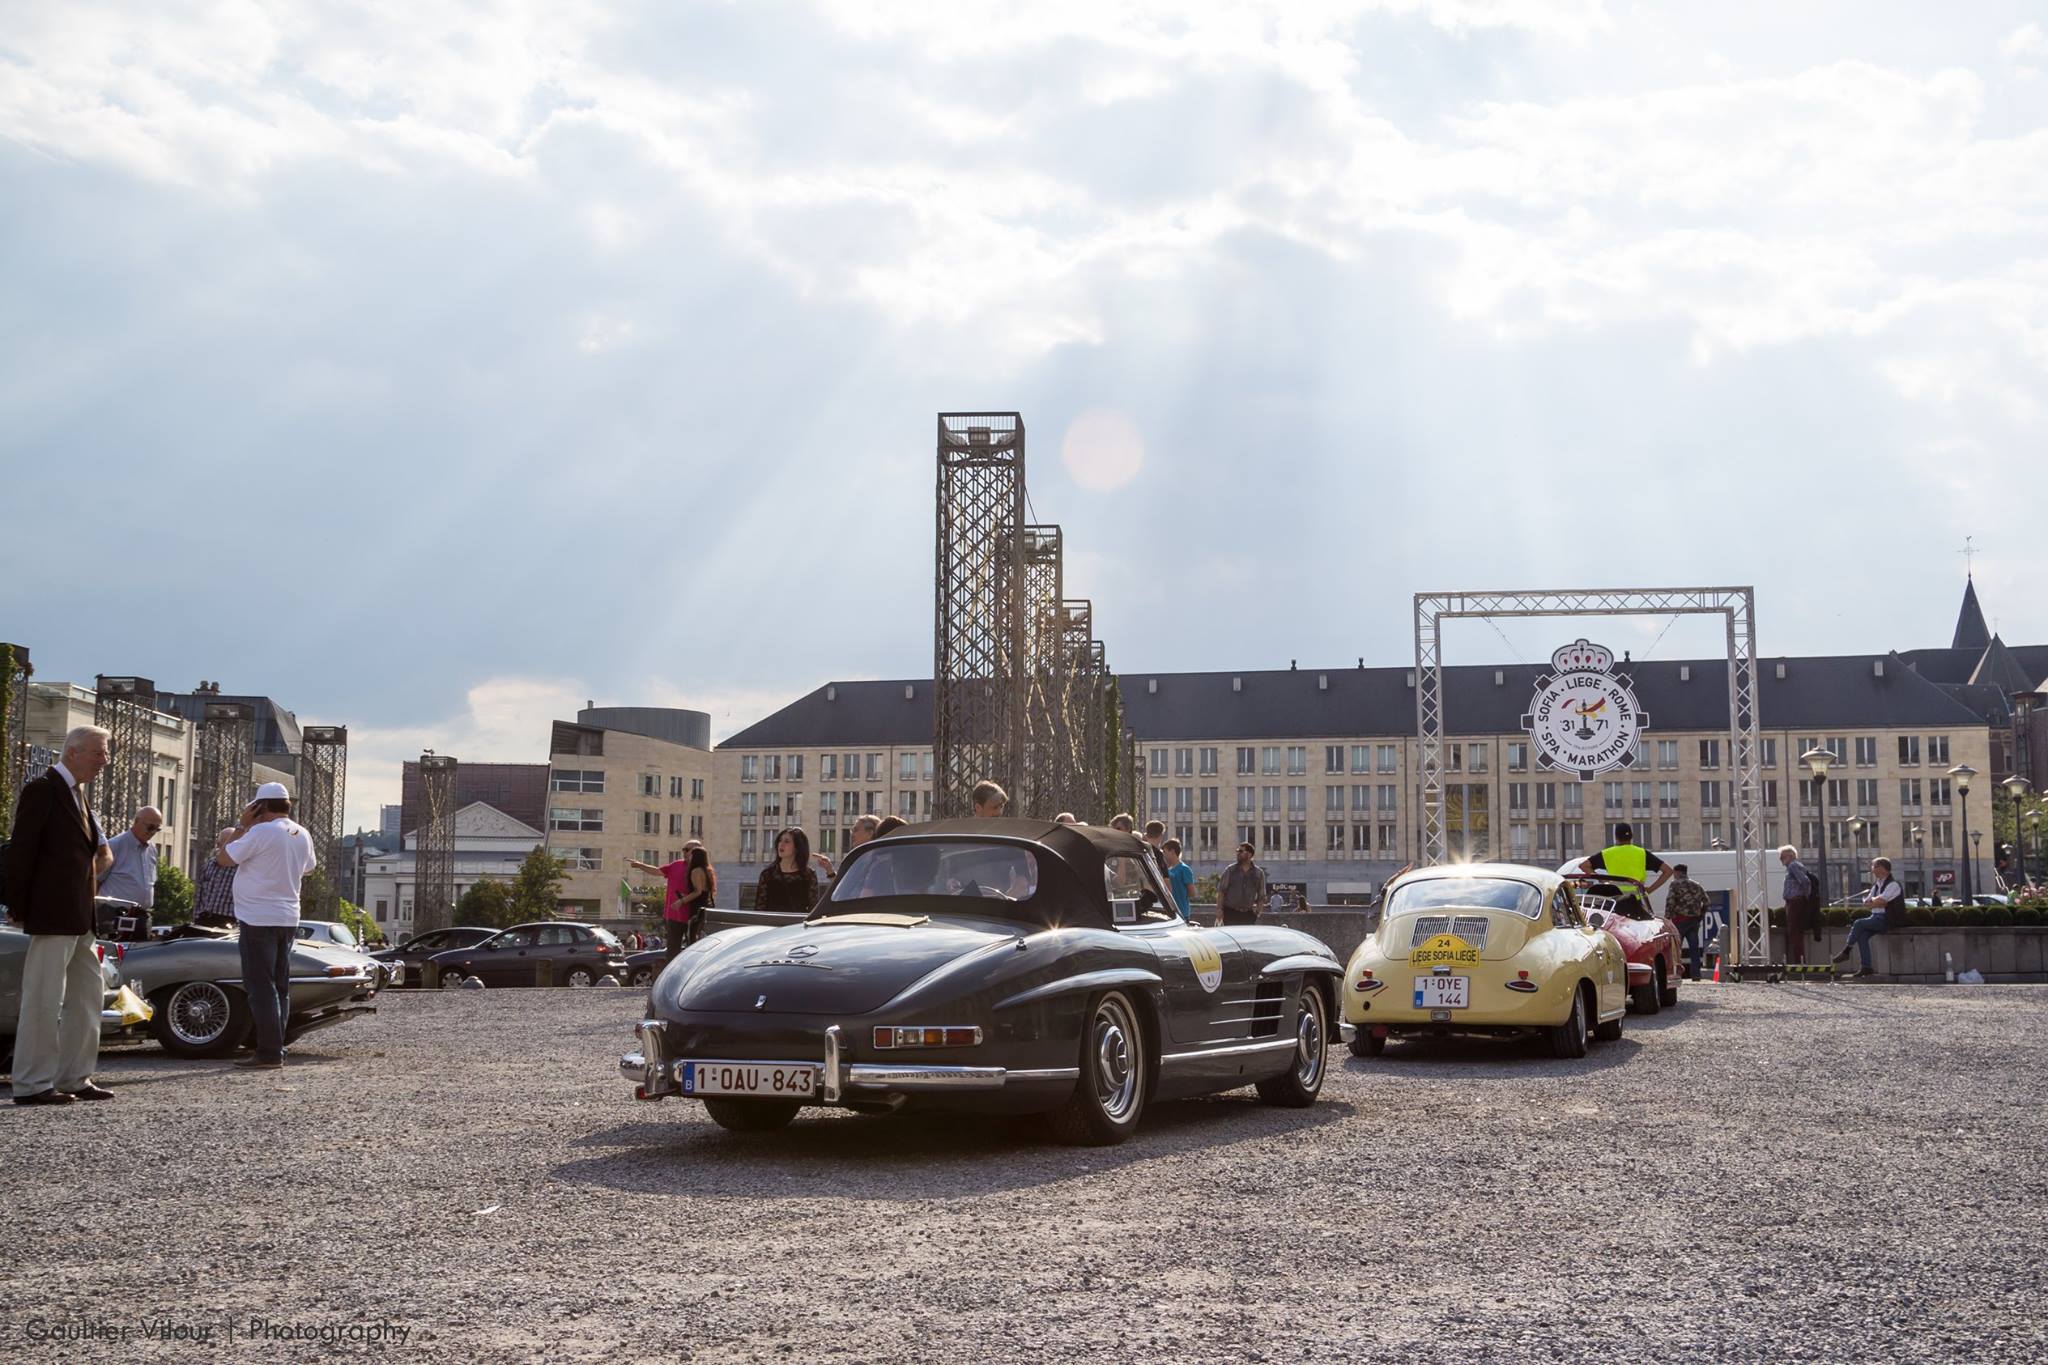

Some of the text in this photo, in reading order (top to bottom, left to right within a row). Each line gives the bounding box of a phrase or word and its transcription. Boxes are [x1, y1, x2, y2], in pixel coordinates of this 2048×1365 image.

[1538, 676, 1632, 722] SOFIA LIEGE ROME
[1541, 731, 1630, 766] SPA MARATHON
[1437, 939, 1450, 948] 24
[1412, 949, 1477, 963] LIEGE SOFIA LIEGE
[1438, 993, 1461, 1005] 144
[685, 1079, 692, 1090] B
